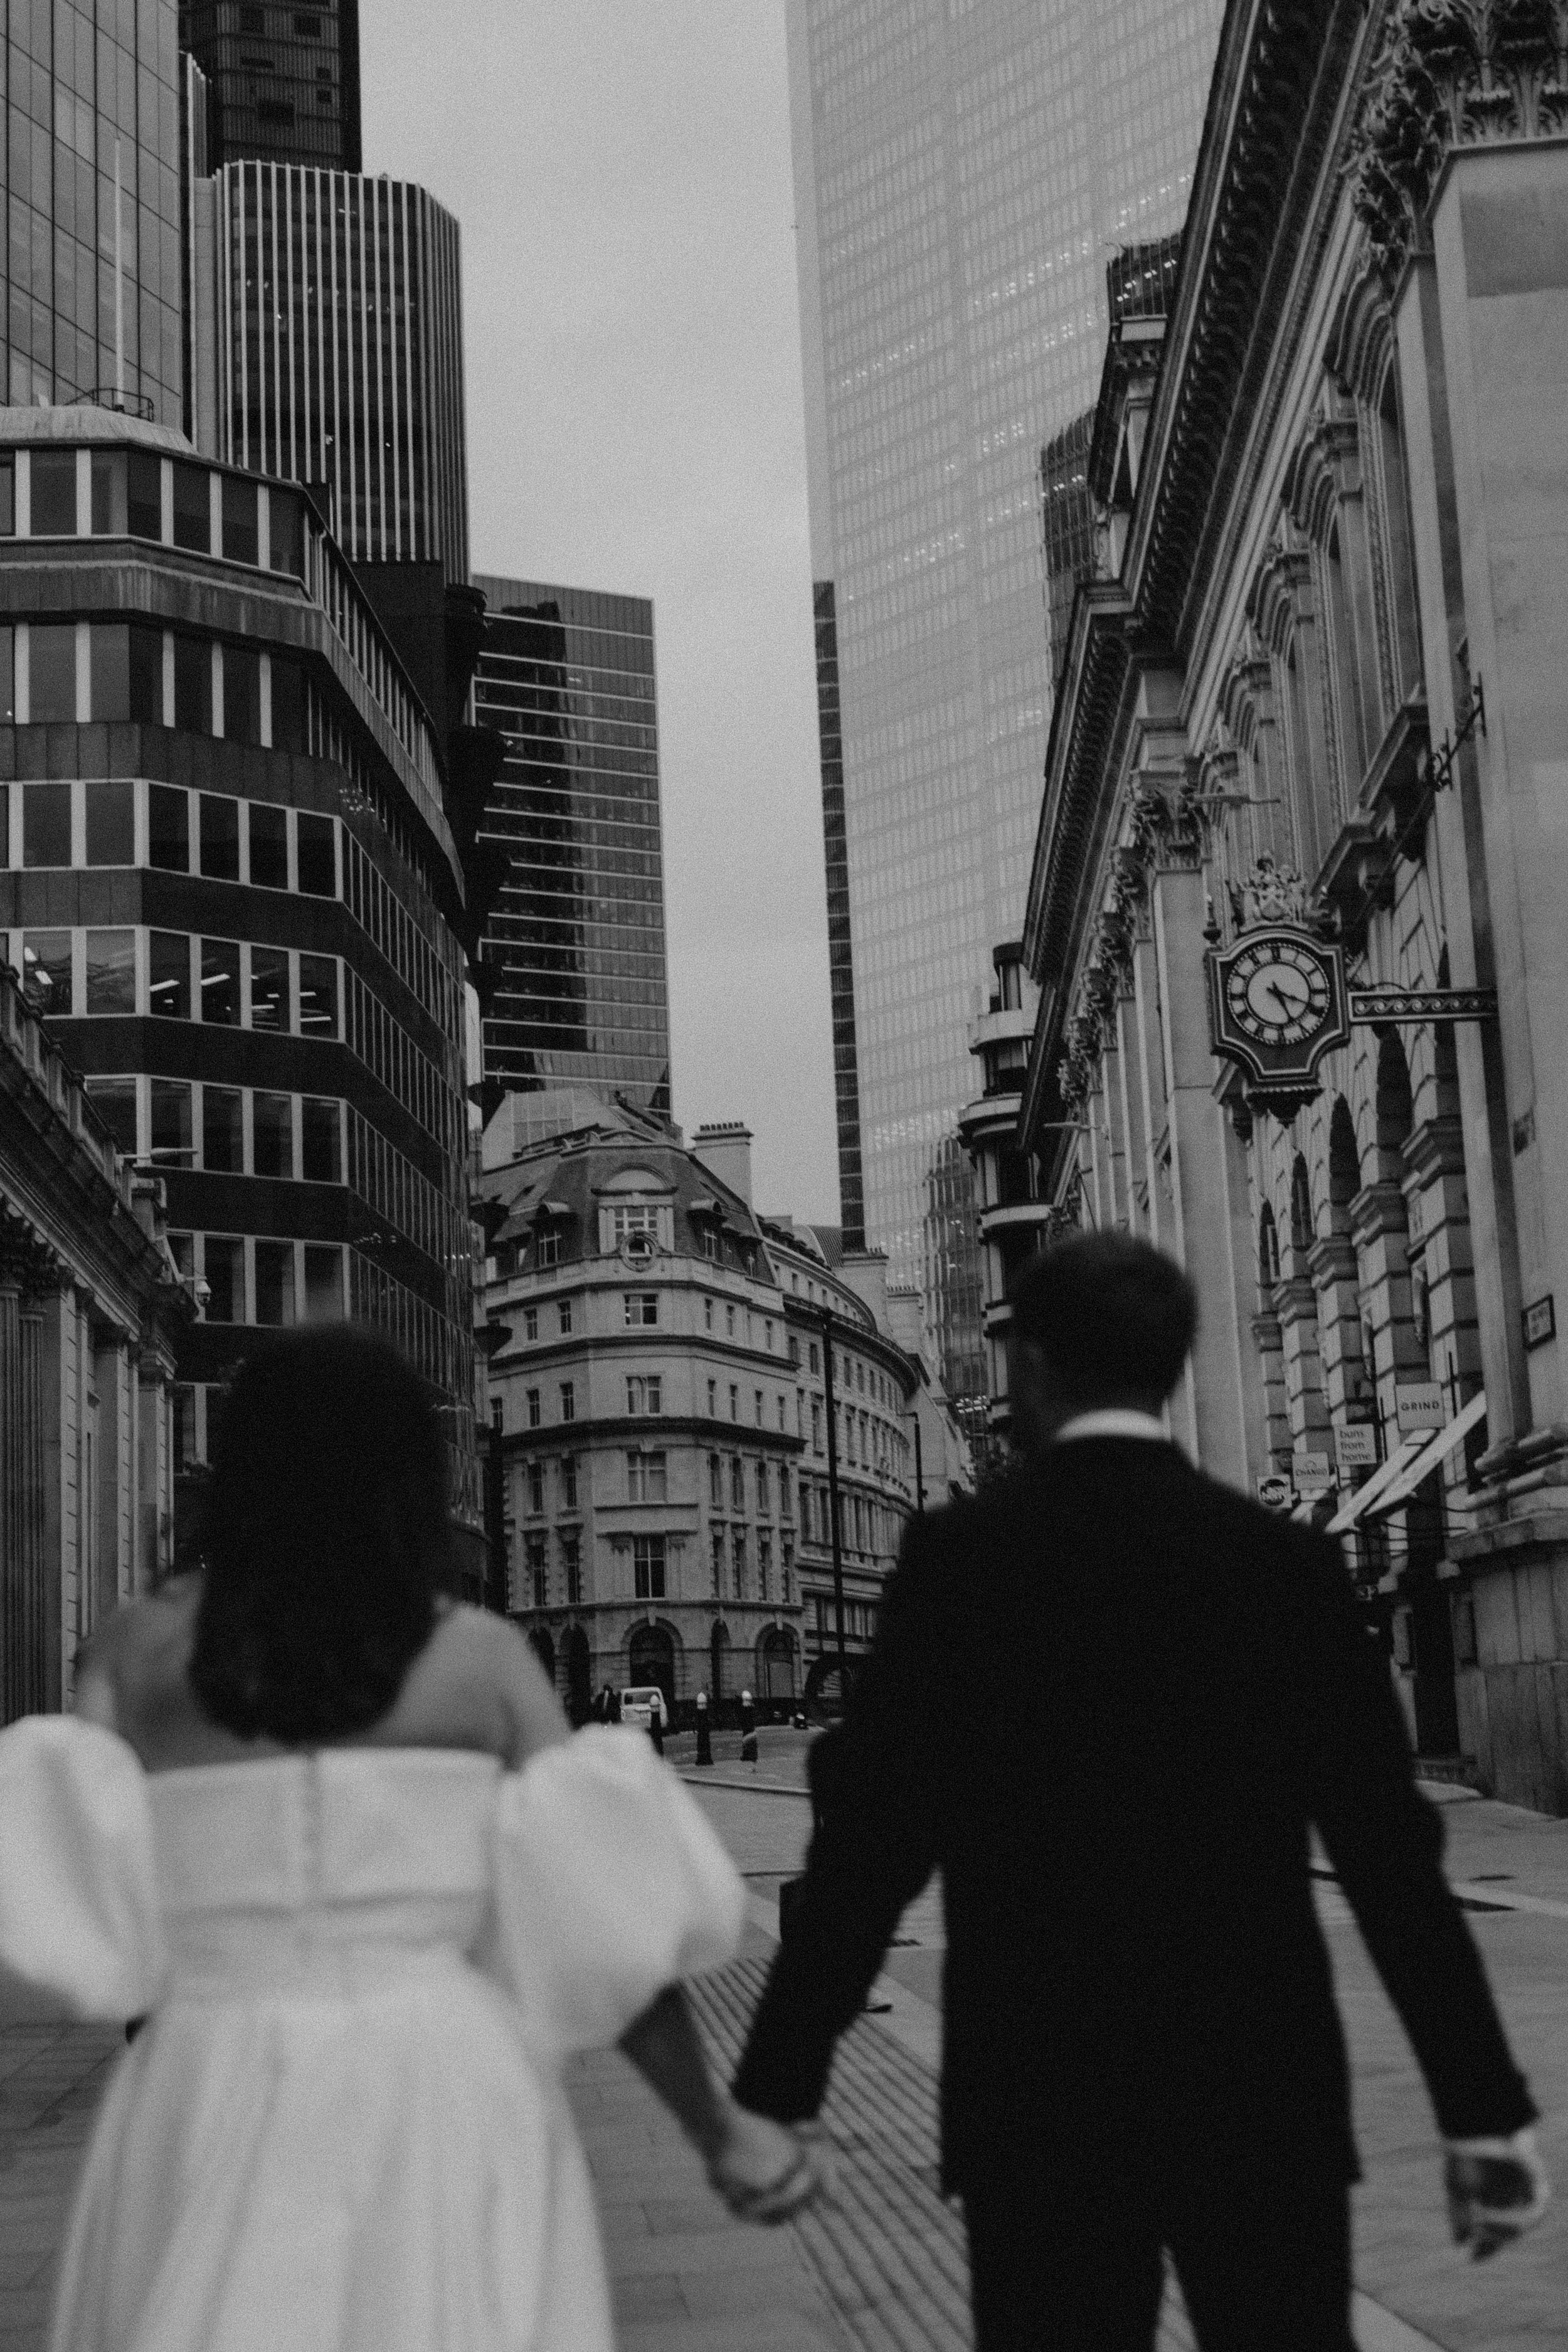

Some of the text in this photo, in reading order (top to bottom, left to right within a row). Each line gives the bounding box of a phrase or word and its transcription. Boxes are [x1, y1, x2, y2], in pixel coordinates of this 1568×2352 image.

[1401, 1400, 1440, 1411] GRIND
[1340, 1441, 1365, 1450] from
[1341, 1453, 1372, 1461] home
